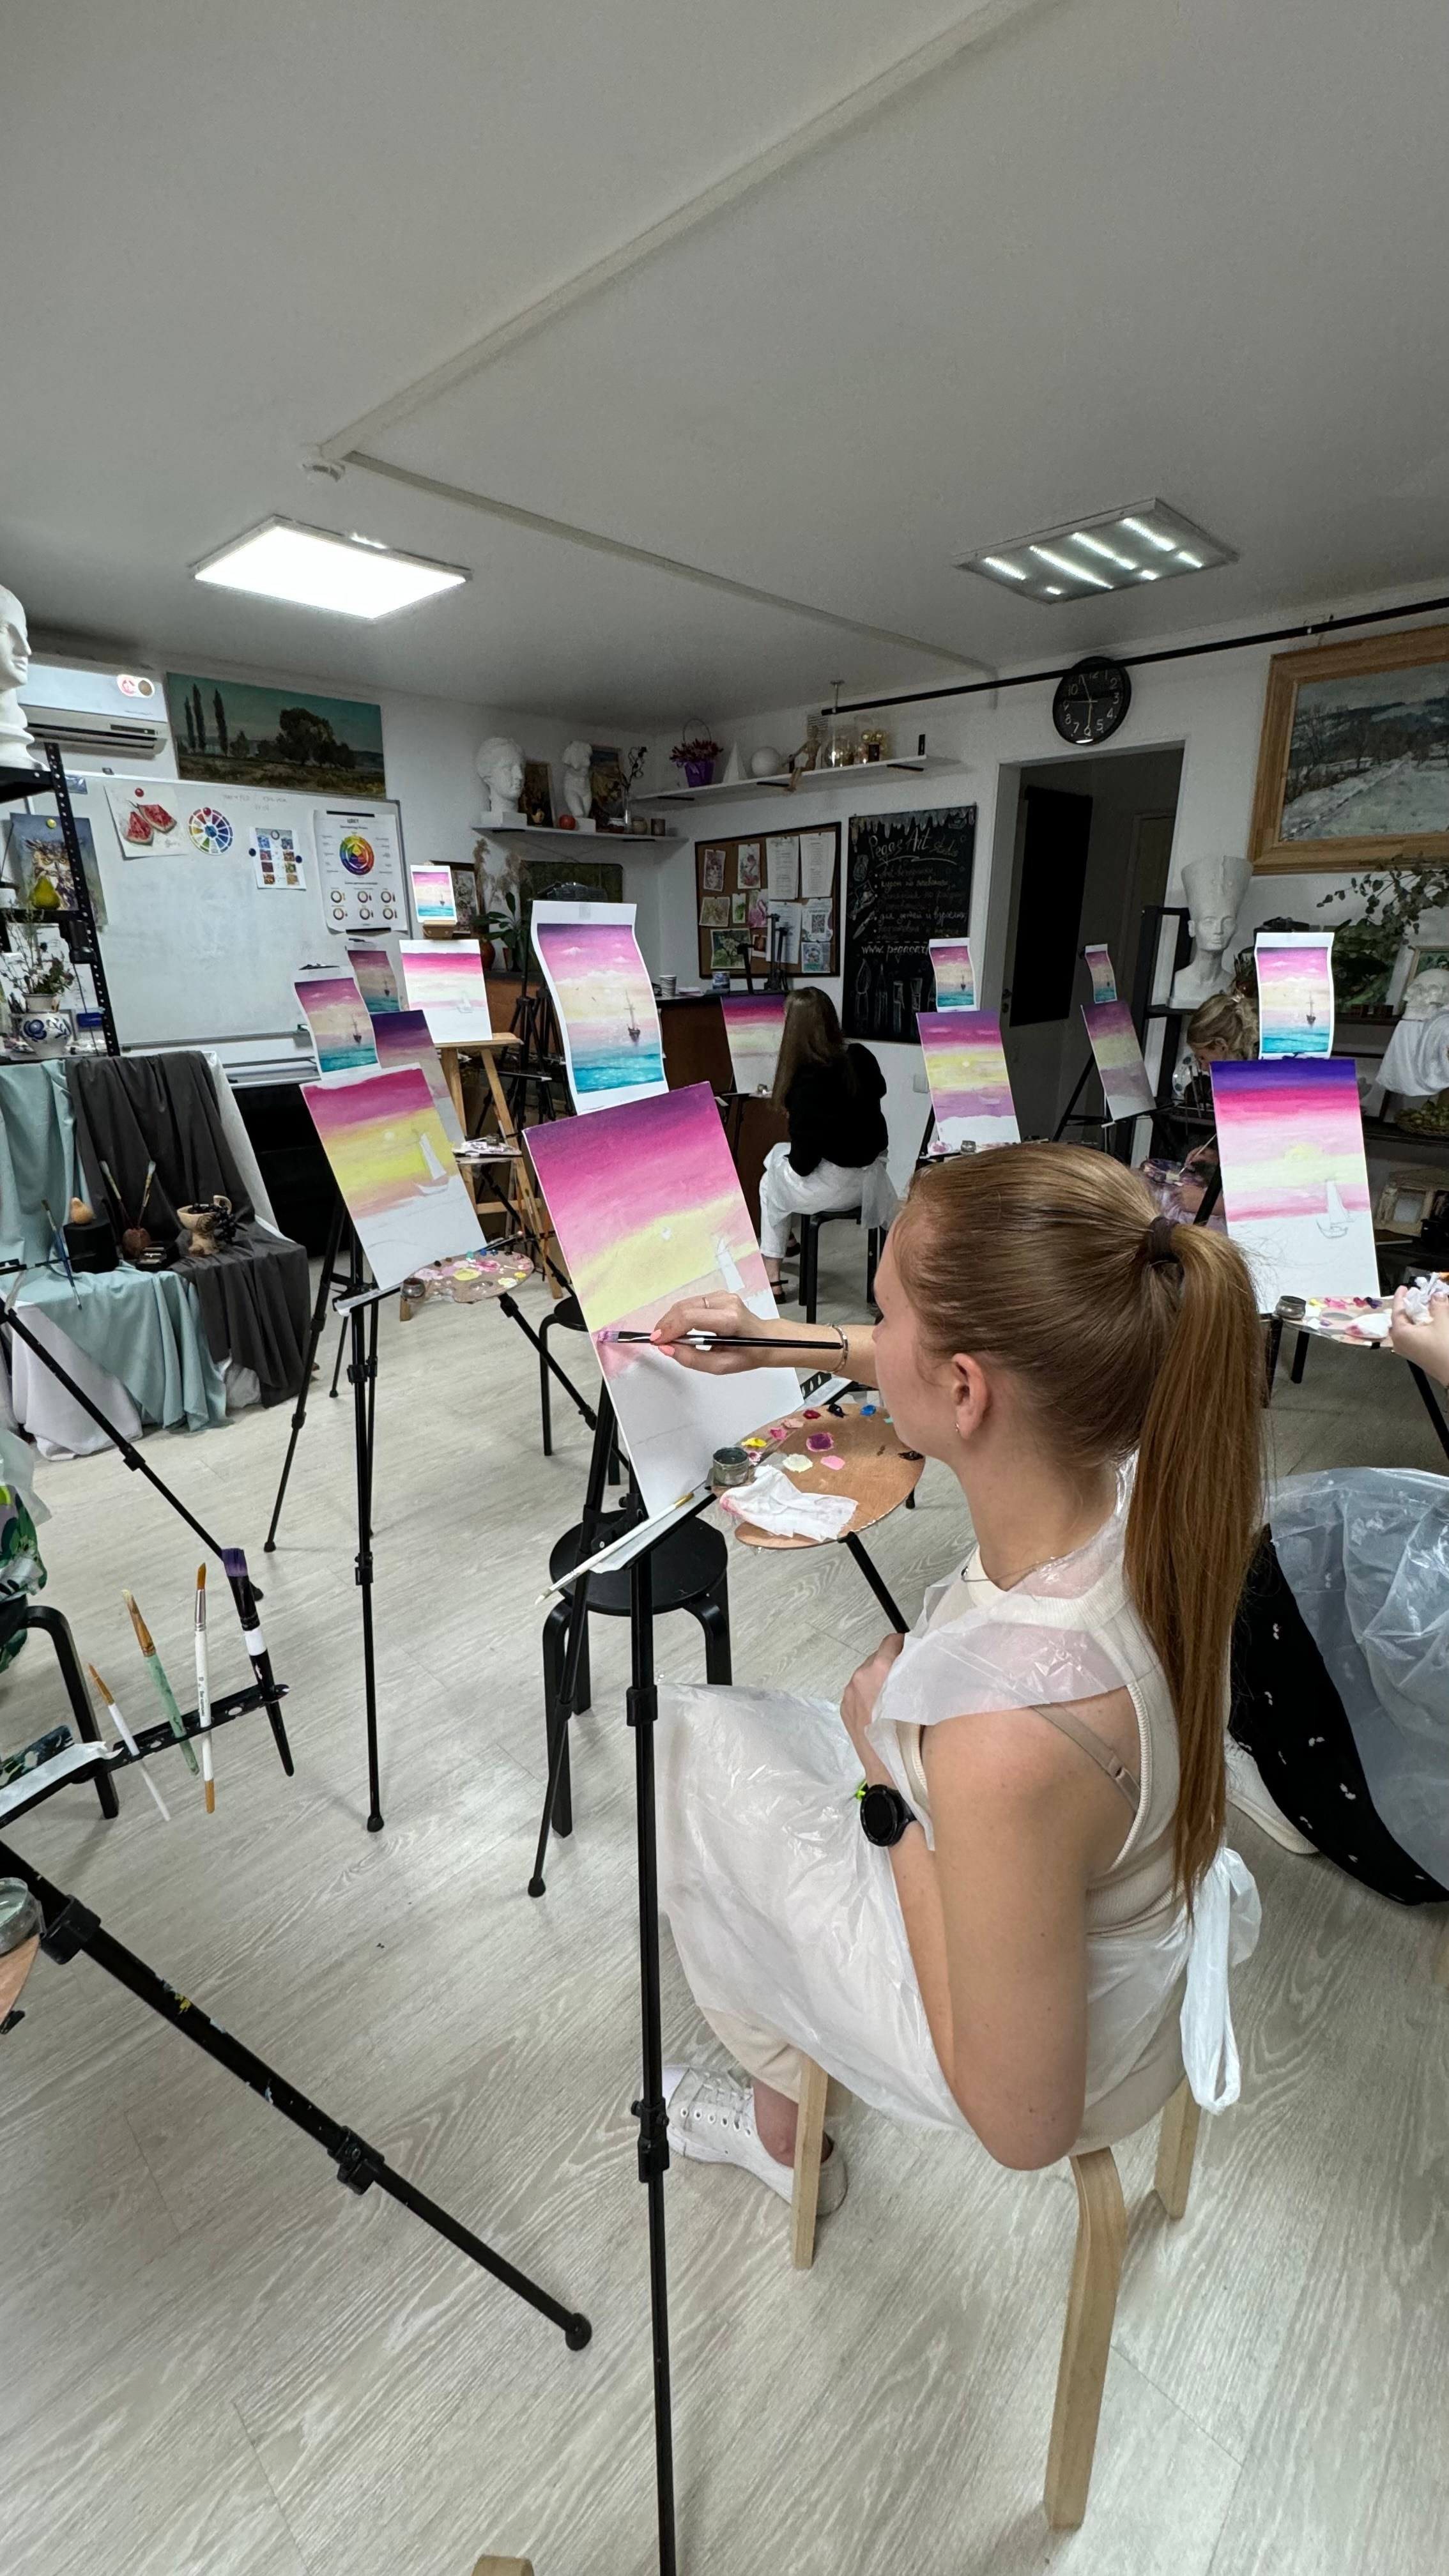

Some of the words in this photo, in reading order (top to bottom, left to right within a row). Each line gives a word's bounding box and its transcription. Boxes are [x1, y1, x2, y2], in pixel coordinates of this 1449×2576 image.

[1068, 683, 1078, 696] 10
[1108, 677, 1118, 690] 2
[1112, 691, 1120, 705] 3
[1062, 700, 1070, 711] 9
[1064, 712, 1072, 725] 8
[1106, 707, 1114, 719] 4
[1072, 721, 1080, 734] 7
[1084, 724, 1092, 737] 6
[1096, 717, 1104, 732] 5
[905, 826, 933, 852] Art
[878, 912, 895, 926] для
[897, 911, 923, 924] детей
